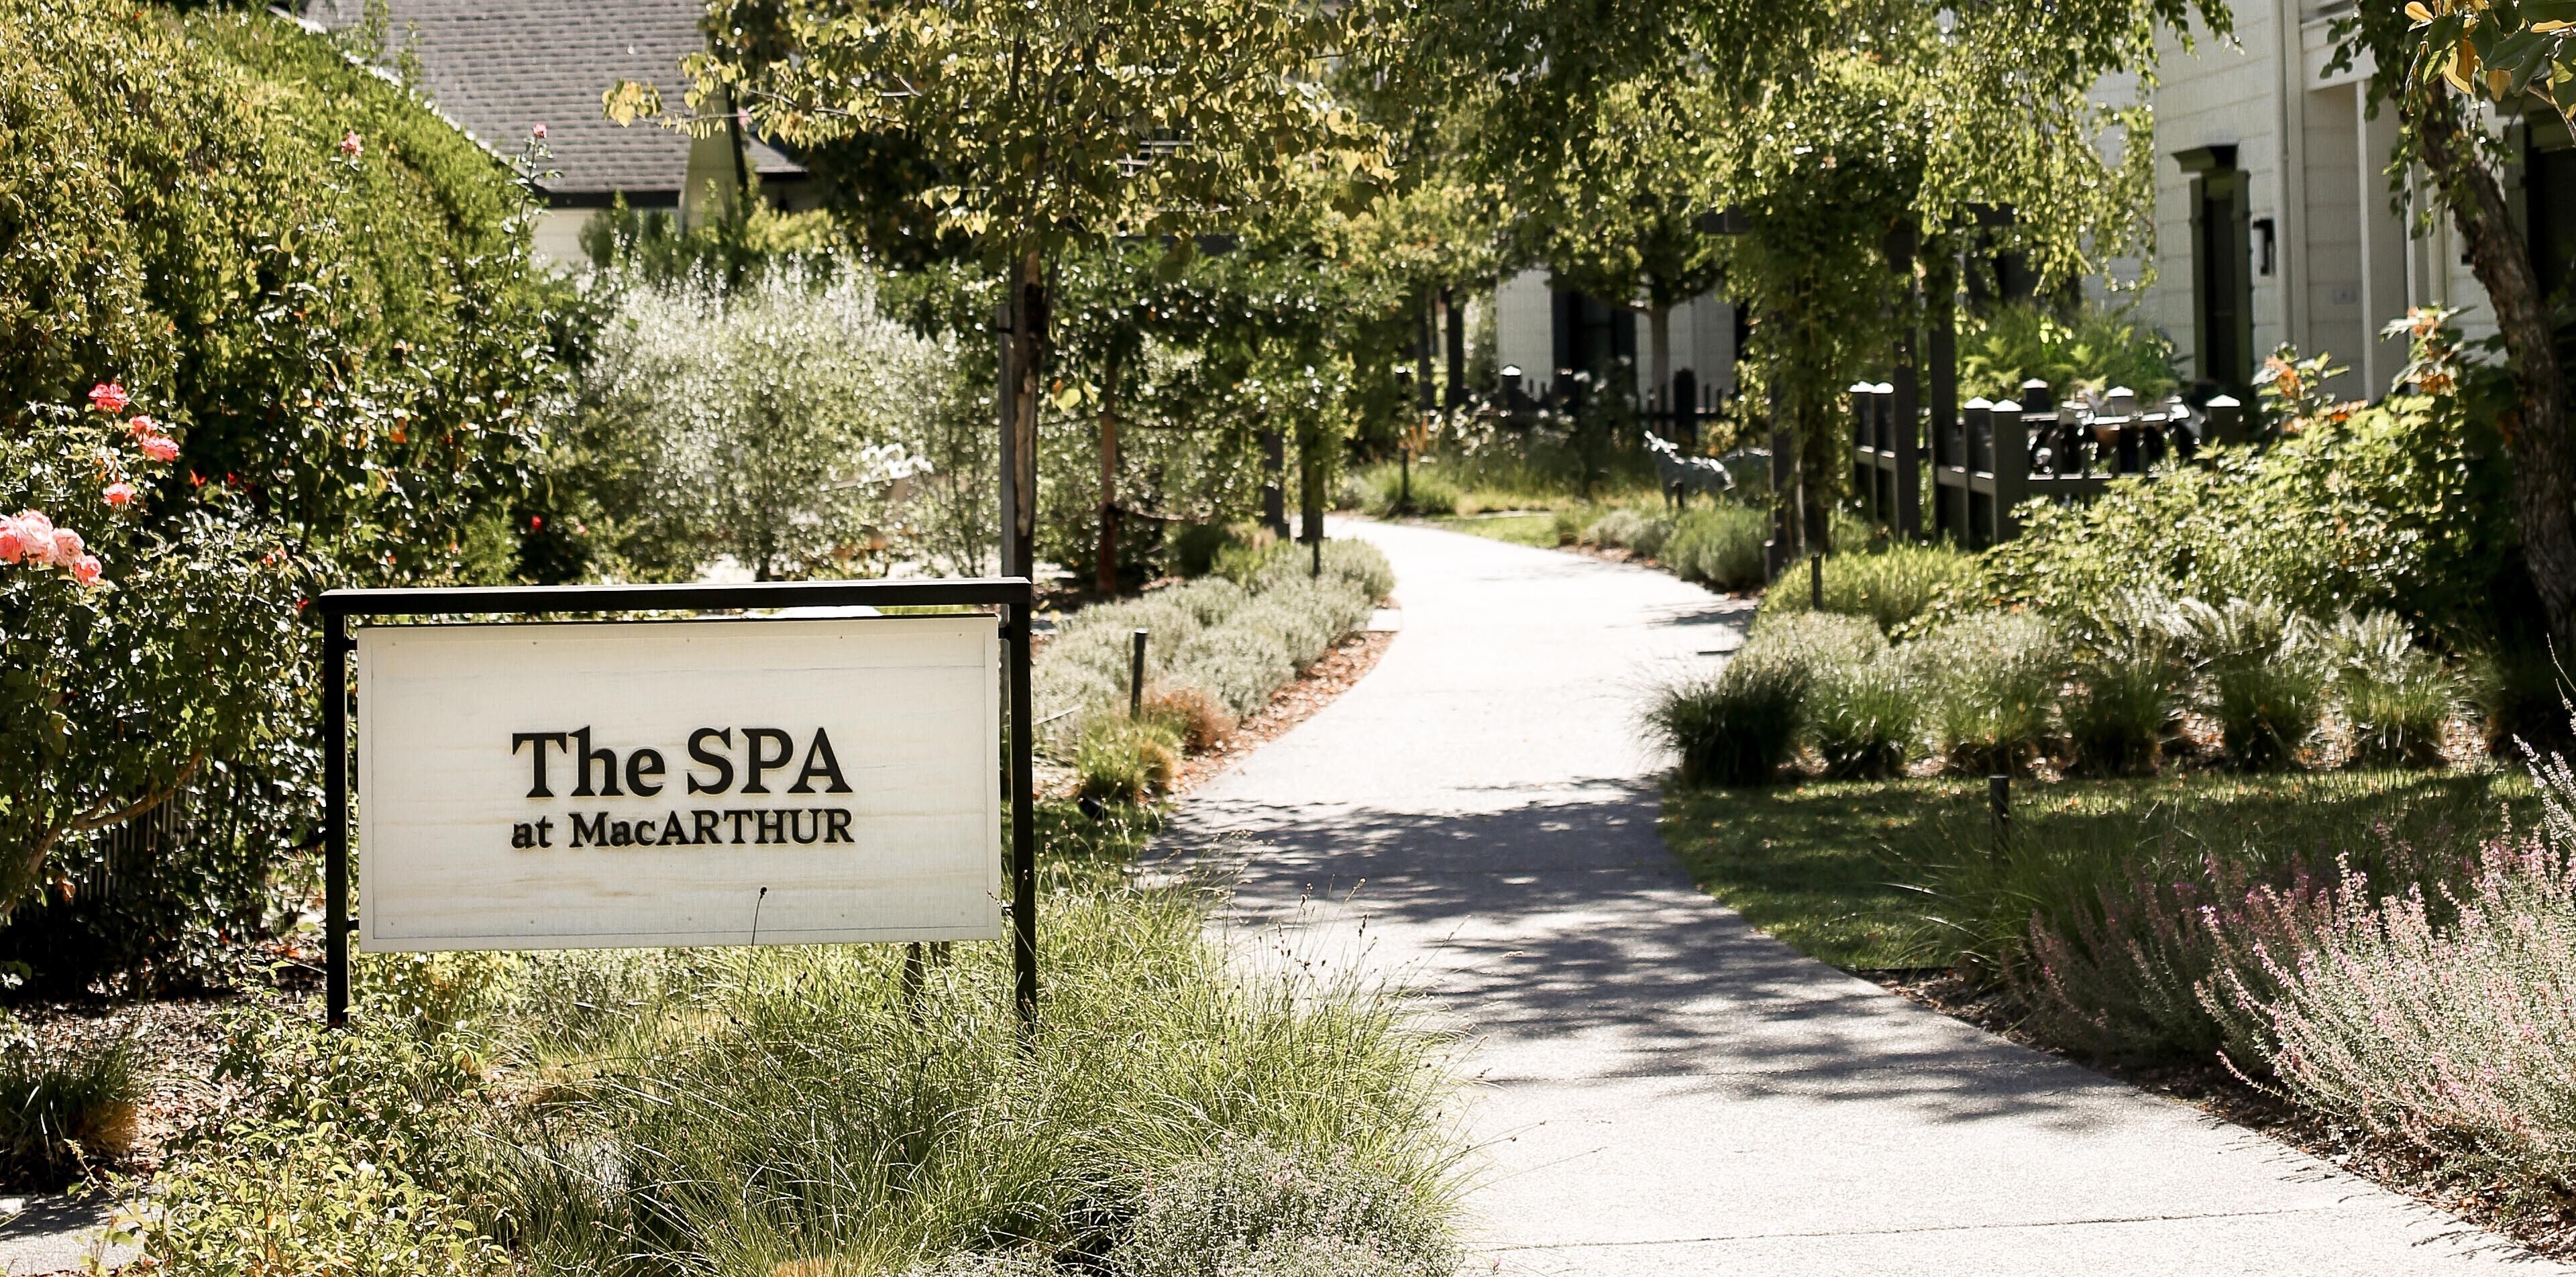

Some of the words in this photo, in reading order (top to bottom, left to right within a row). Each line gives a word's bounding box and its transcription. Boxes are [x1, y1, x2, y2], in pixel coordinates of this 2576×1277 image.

[512, 725, 666, 798] The
[686, 726, 853, 796] SPA
[511, 815, 553, 849] at
[568, 808, 855, 848] MacARTHUR
